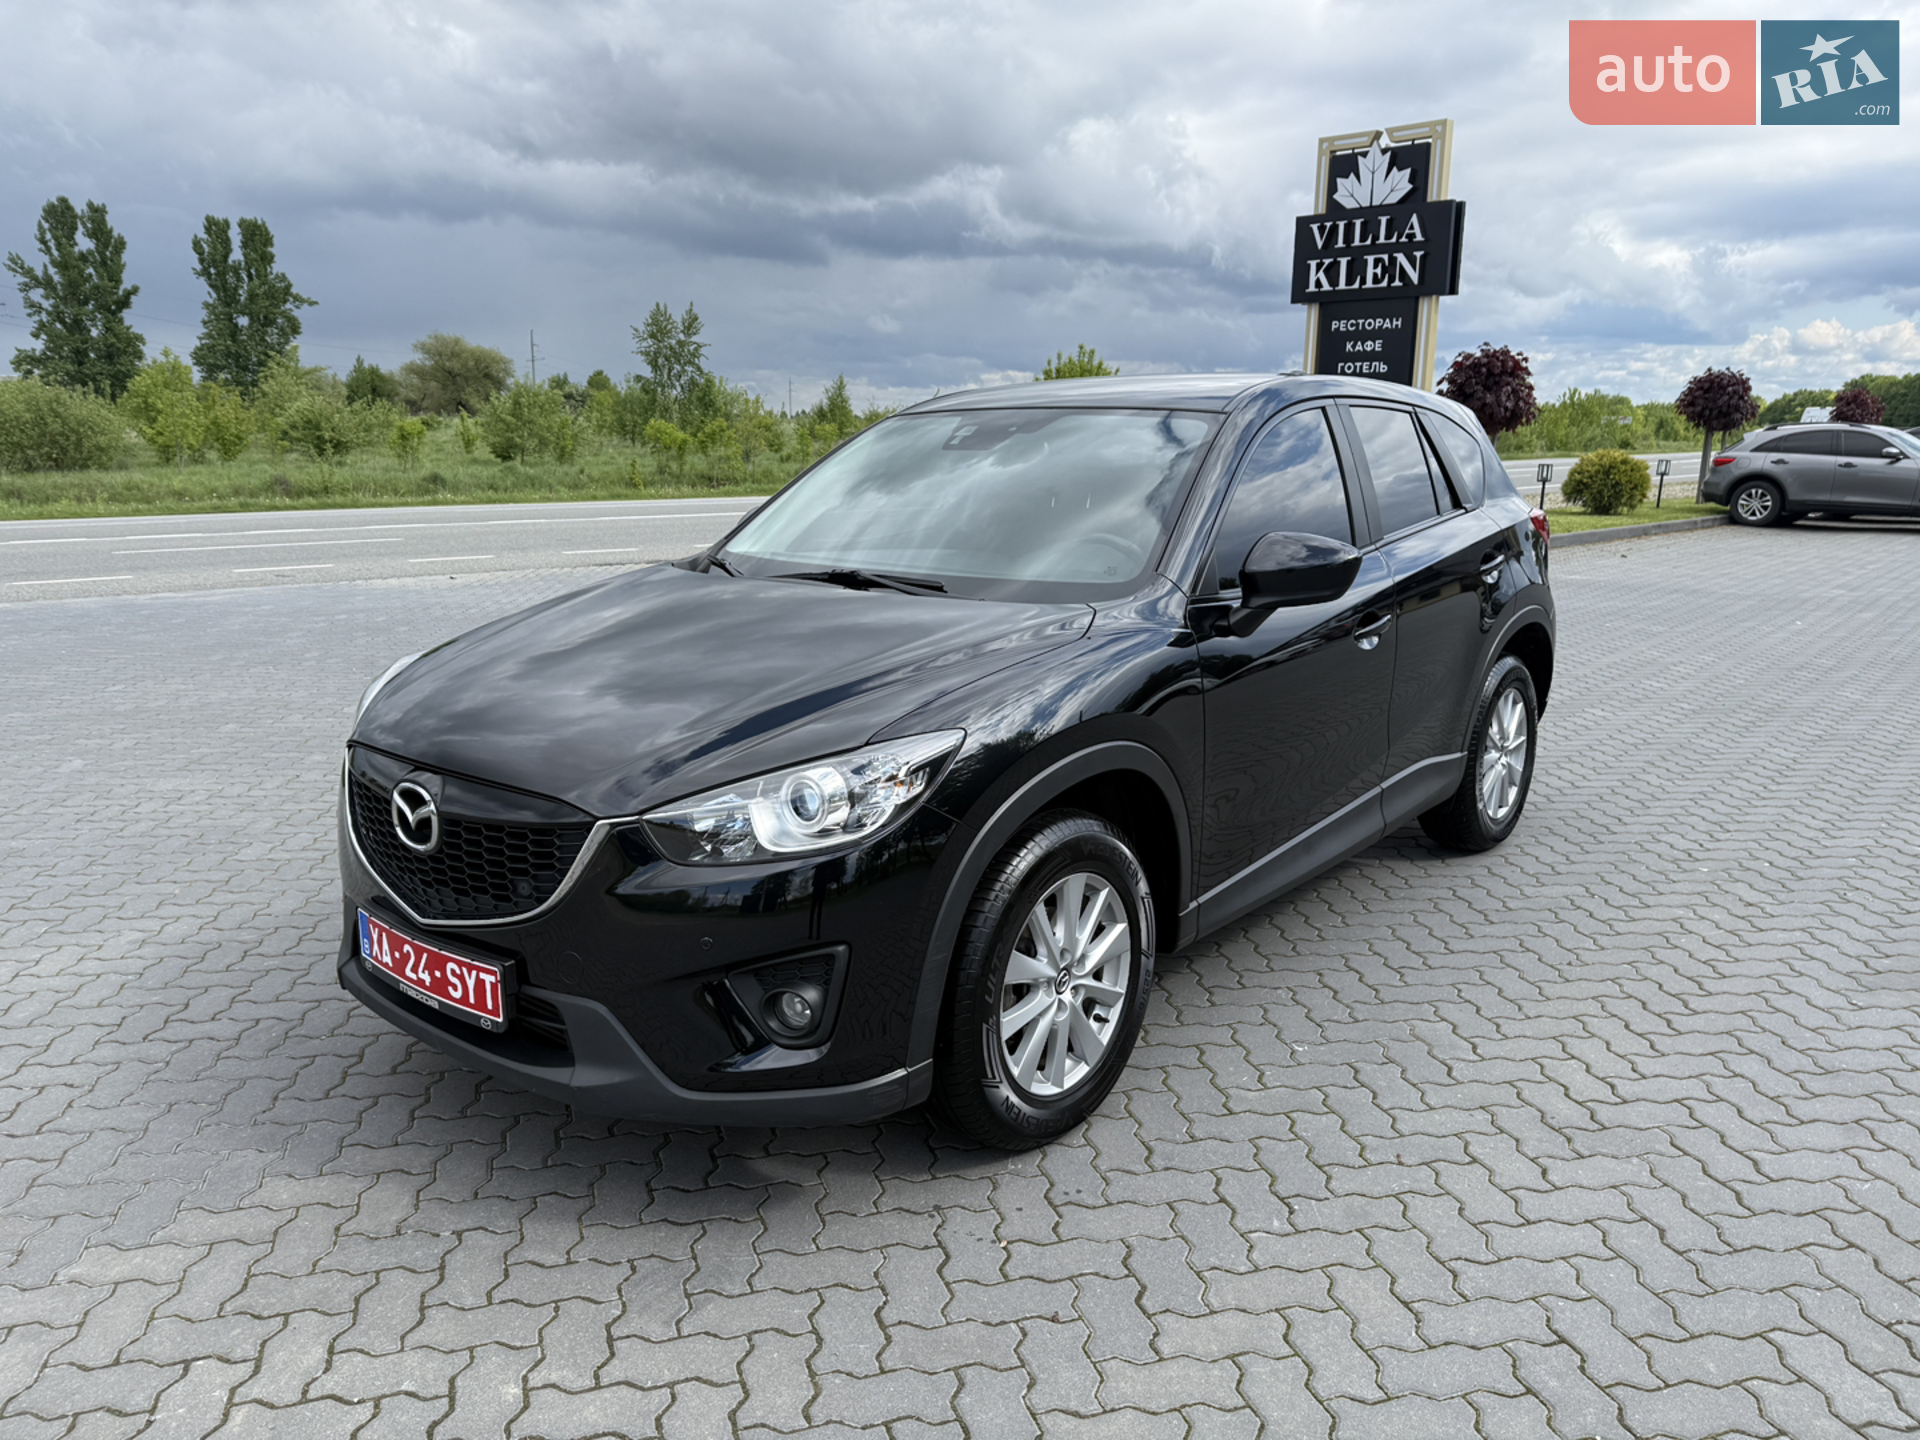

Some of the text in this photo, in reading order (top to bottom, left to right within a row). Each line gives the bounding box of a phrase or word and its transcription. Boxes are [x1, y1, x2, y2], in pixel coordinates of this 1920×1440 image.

[1309, 213, 1425, 250] VILLA
[1305, 251, 1424, 292] KLEN
[1331, 317, 1402, 332] РЕСТОРАН
[1345, 340, 1383, 353] КАФЕ
[1337, 361, 1388, 374] ГОТЕЛЬ
